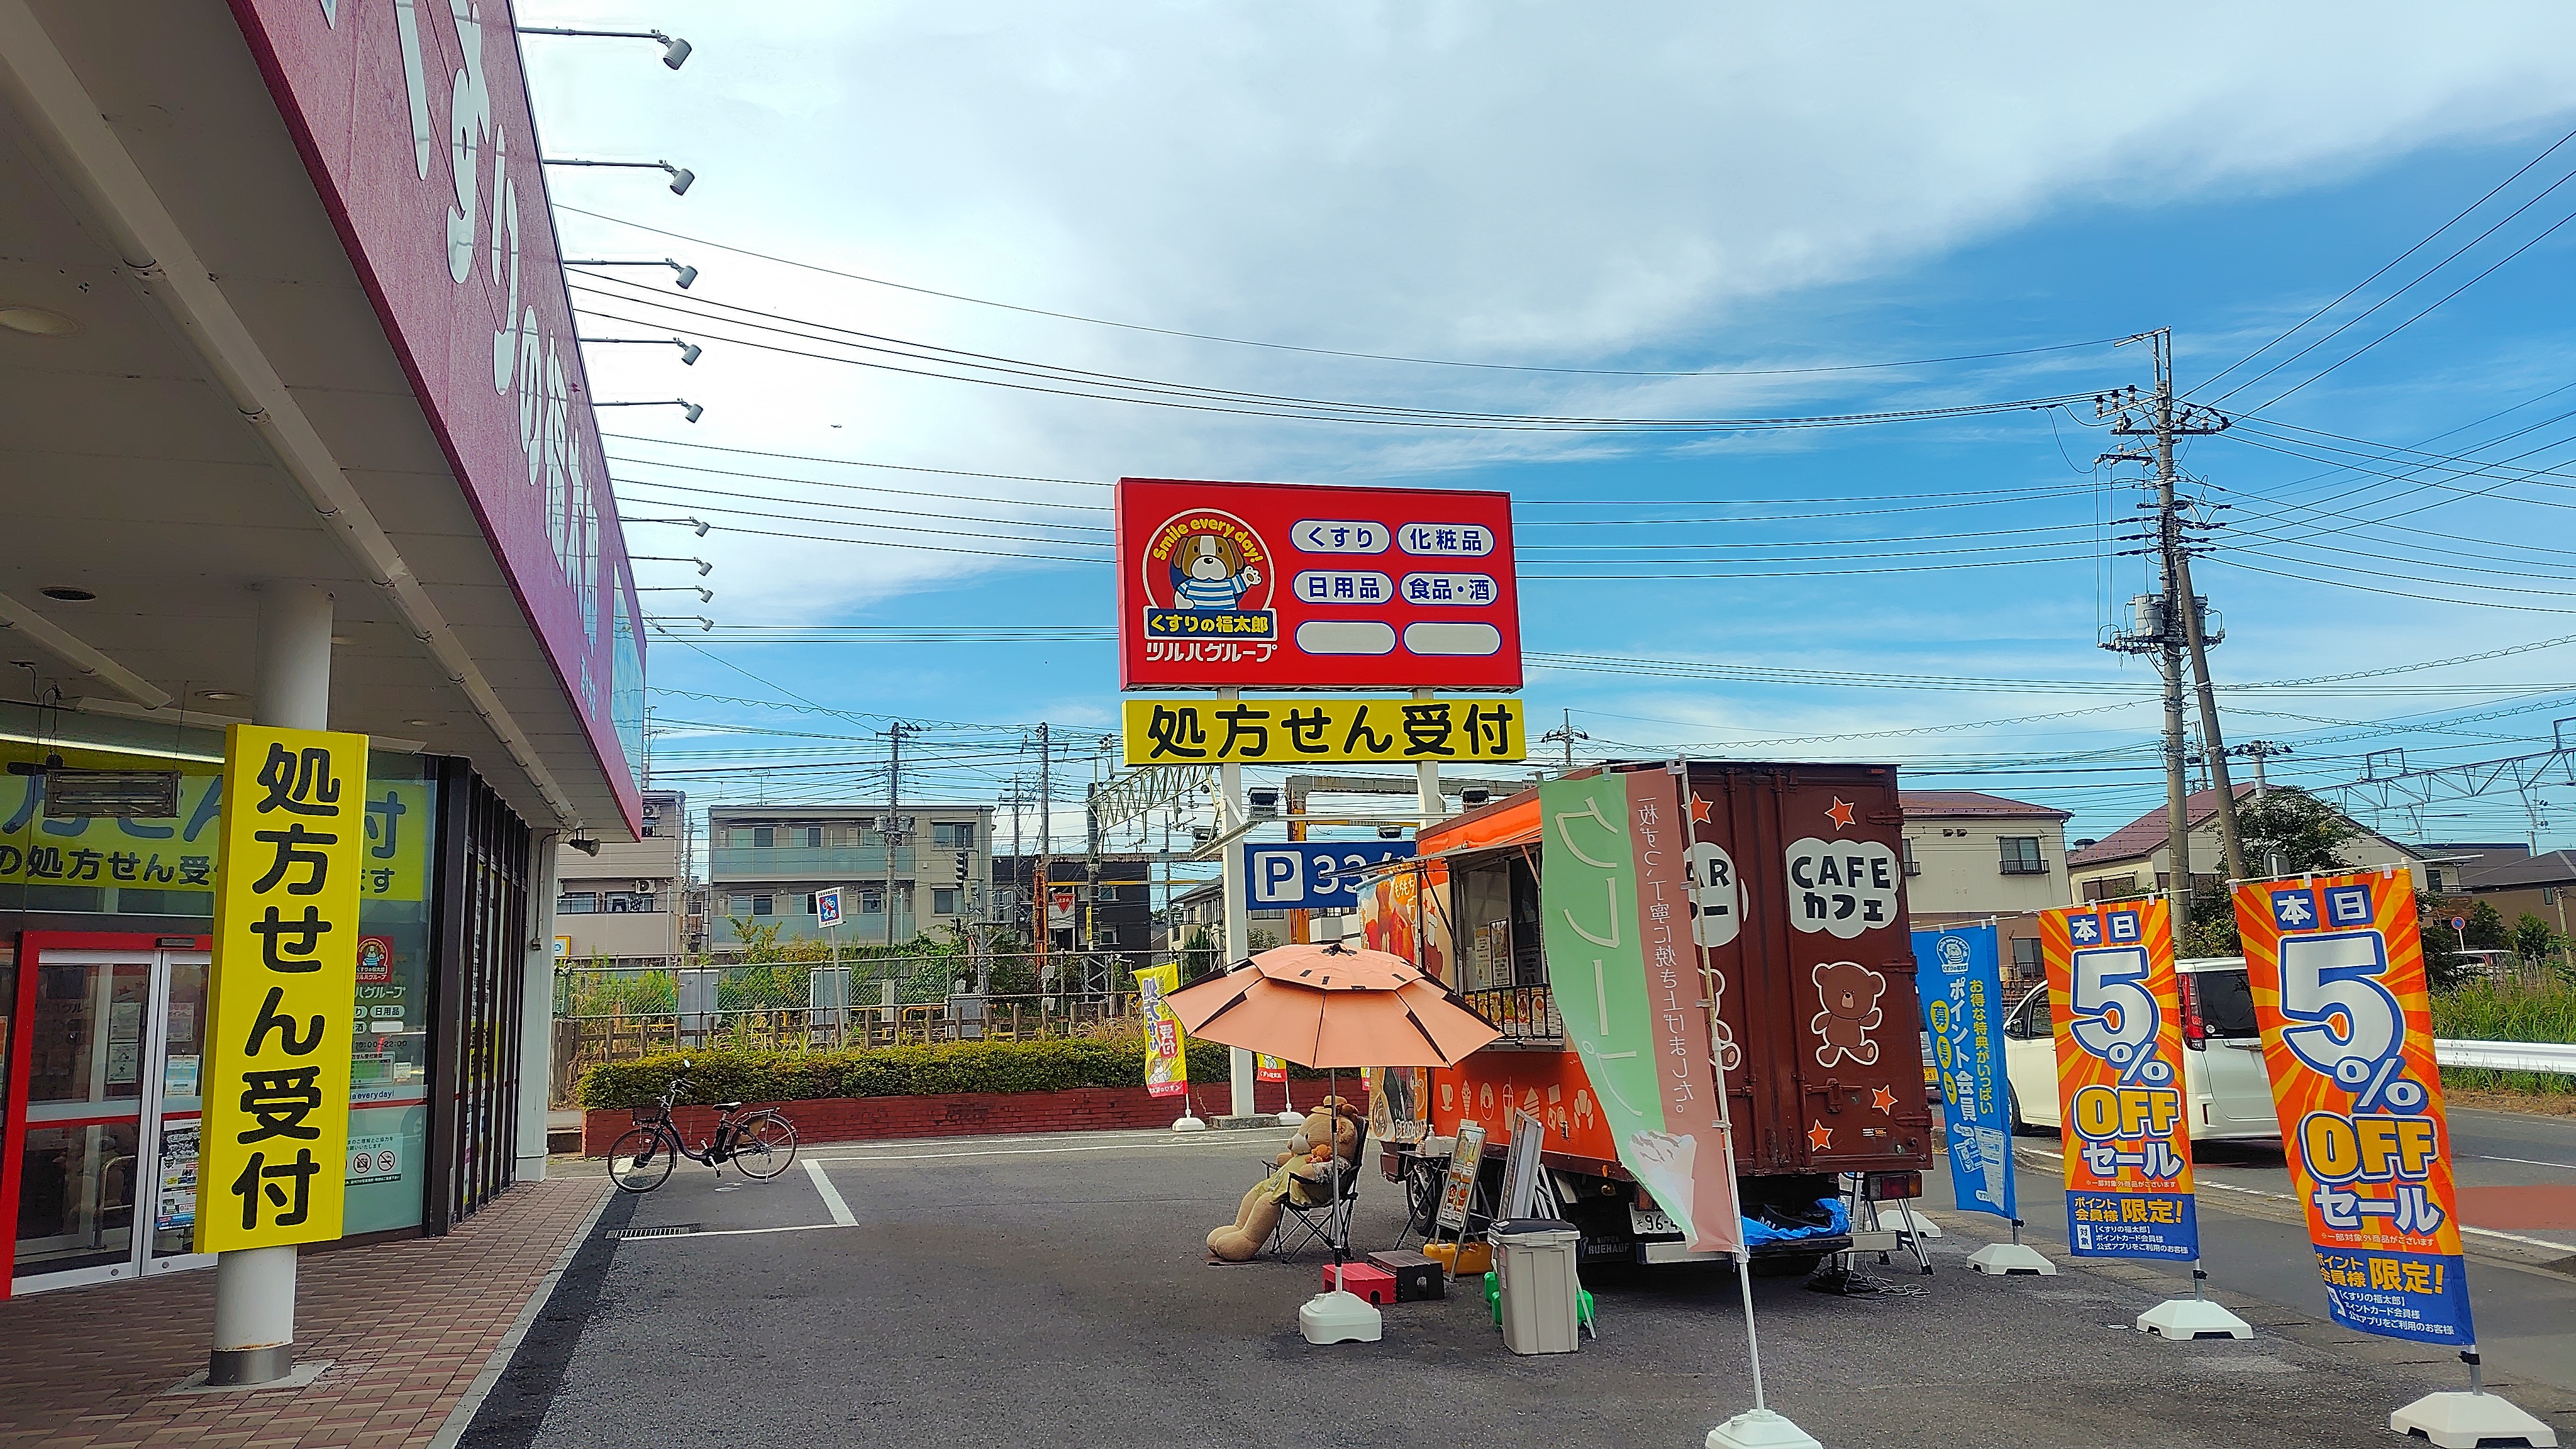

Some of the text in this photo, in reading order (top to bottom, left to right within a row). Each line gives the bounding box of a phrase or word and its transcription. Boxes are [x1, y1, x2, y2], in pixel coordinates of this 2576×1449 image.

[1153, 519, 1263, 563] Smile every day!
[1308, 527, 1374, 548] くすり
[1409, 528, 1482, 552] 化粧品
[1309, 577, 1380, 599] 日用品
[1409, 579, 1489, 601] 食品・酒
[1152, 614, 1268, 633] くすりの福太郎
[1146, 642, 1278, 662] ツルハグループ
[1147, 704, 1513, 758] 処方せん受付
[1265, 857, 1294, 897] P
[1791, 855, 1891, 889] CAFE
[1803, 892, 1884, 922] カフェ
[2277, 891, 2366, 928] 本日
[2073, 915, 2137, 942] 本日
[231, 741, 340, 1230] 処方せん受付
[375, 1007, 400, 1016] 日用品
[2072, 950, 2169, 1082] 5%
[2282, 935, 2421, 1108] 5%
[1950, 977, 1977, 1122] ポイント会員
[1969, 979, 1994, 1114] お得な特典がいっぱい
[2077, 1089, 2178, 1136] OFF
[2083, 1142, 2181, 1178] セール
[2304, 1117, 2436, 1180] OFF
[2075, 1197, 2117, 1209] ポイント
[2075, 1209, 2119, 1223] 会員様
[2316, 1185, 2441, 1231] セール
[2080, 1228, 2089, 1246] 対象
[2096, 1235, 2164, 1243] ポイントカード会員様
[2096, 1243, 2189, 1254] 公式アプリをご利用のお客様
